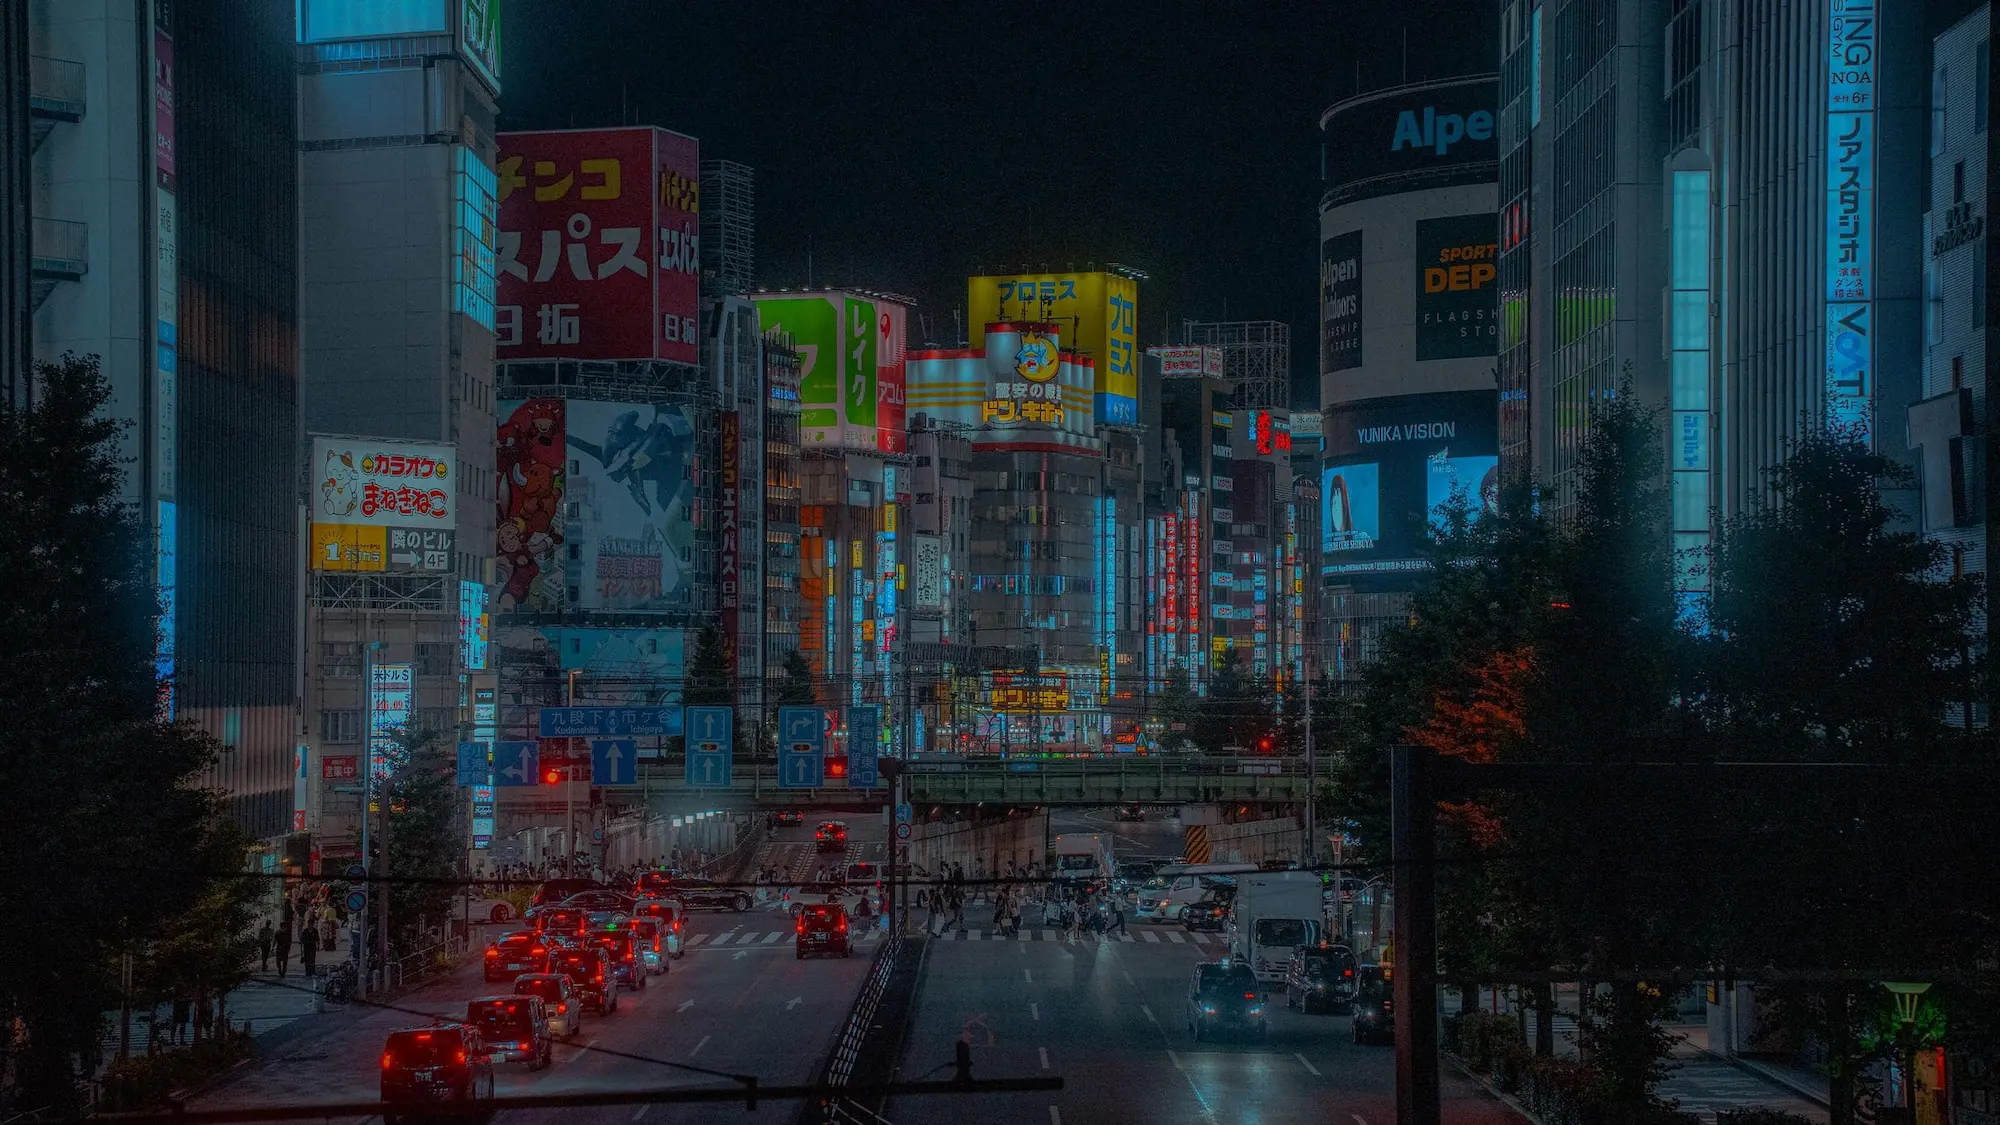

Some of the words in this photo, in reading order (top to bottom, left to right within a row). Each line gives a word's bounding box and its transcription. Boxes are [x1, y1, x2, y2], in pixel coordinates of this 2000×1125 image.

[1831, 71, 1872, 85] NOA
[1852, 92, 1870, 104] 6F
[1391, 105, 1499, 156] Alpe
[1839, 117, 1862, 263] ノアスタジオ
[1323, 258, 1357, 292] Alpen
[1836, 278, 1865, 289] ダンス
[997, 280, 1077, 302] プロミス
[664, 314, 697, 344] 日拓
[852, 304, 867, 407] レイク
[771, 387, 797, 401] SHISHA
[879, 381, 904, 406] アコム
[1358, 426, 1401, 444] YUNIKA
[1404, 421, 1456, 441] VISION
[374, 454, 436, 478] カラオケ
[361, 480, 448, 518] まねきねこ
[391, 529, 451, 549] 隣のビル
[722, 488, 737, 574] エスパス
[427, 554, 446, 567] 4F
[374, 670, 400, 681] 米ドル
[551, 710, 603, 725] 九段下
[851, 713, 861, 750] Shinjuku
[861, 711, 874, 784] 新宿駅東口
[324, 766, 354, 778] 営業中
